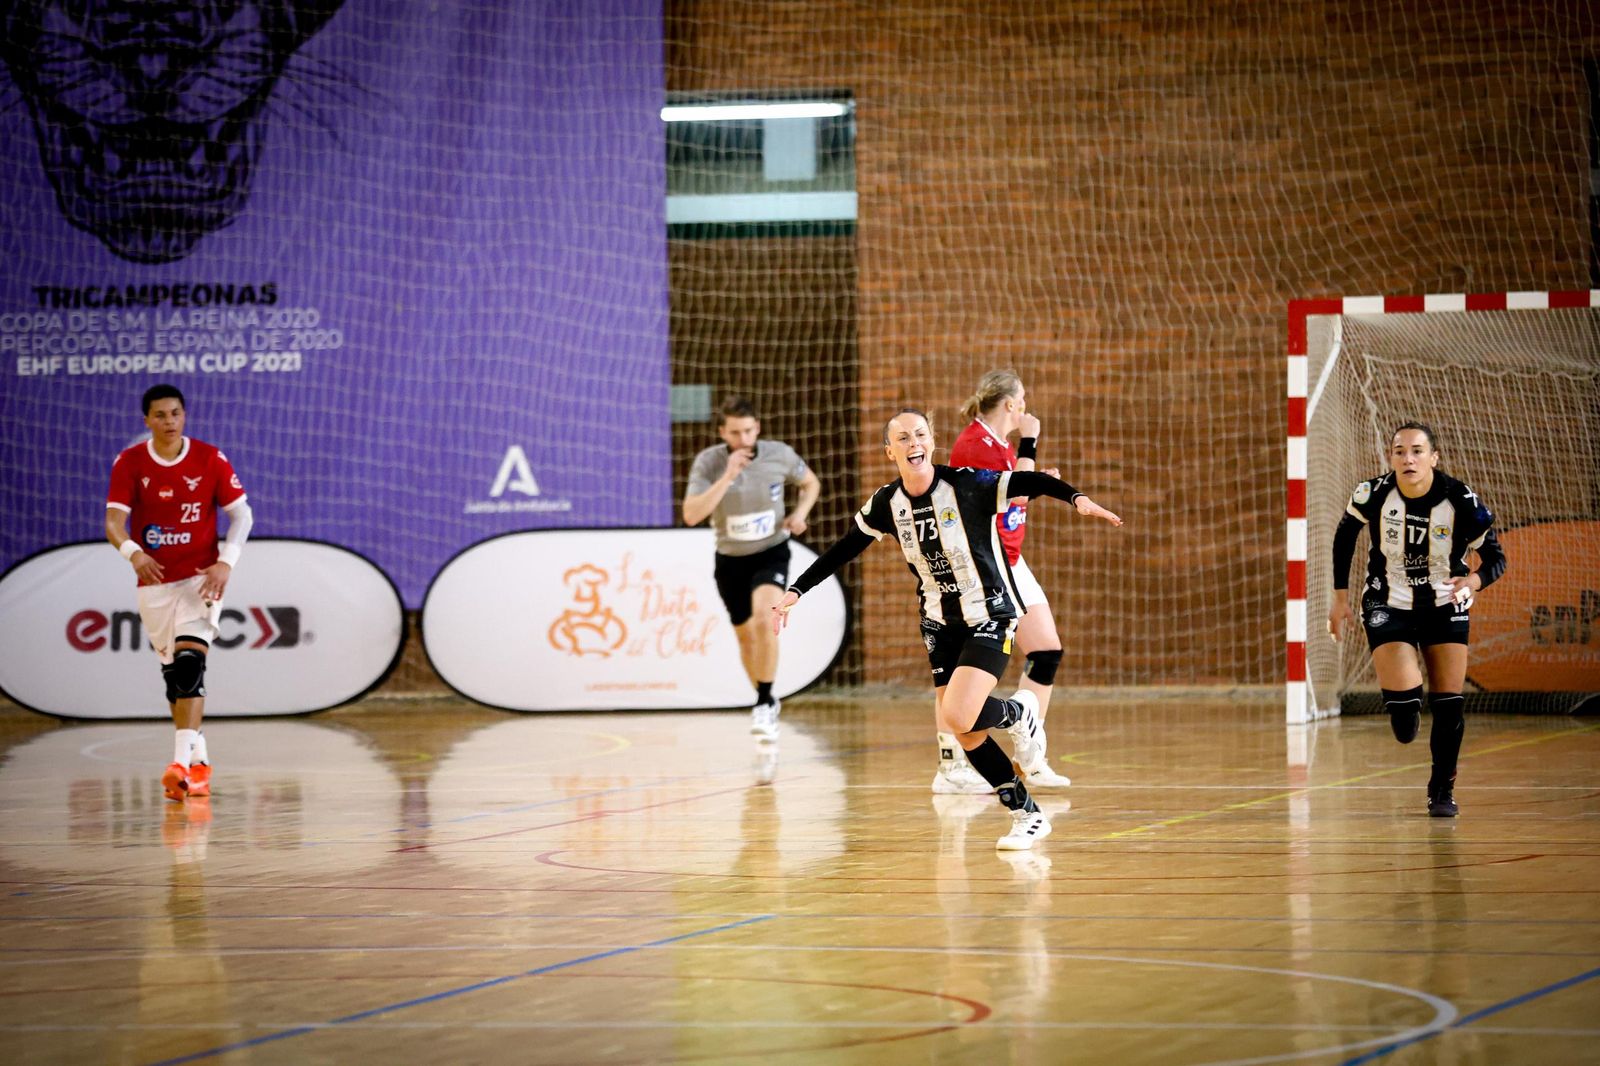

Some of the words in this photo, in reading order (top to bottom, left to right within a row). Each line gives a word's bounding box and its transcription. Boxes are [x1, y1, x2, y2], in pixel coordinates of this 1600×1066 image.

[33, 283, 277, 309] TRICAMPEONAS
[0, 312, 63, 333] COPA
[68, 311, 101, 332] DE
[156, 310, 185, 331] LA
[189, 308, 260, 331] REINA
[264, 307, 320, 329] 2020
[0, 333, 112, 355] PERCOPA
[116, 332, 148, 353] DE
[251, 329, 284, 351] DE
[289, 328, 343, 350] 2020
[17, 355, 62, 376] EHF
[67, 353, 195, 375] EUROPEAN
[200, 352, 248, 373] CUP
[251, 351, 302, 373] 2021
[180, 502, 201, 523] 25
[146, 532, 191, 545] extra
[915, 518, 939, 542] 73
[1407, 525, 1427, 544] 17
[66, 609, 246, 654] emc
